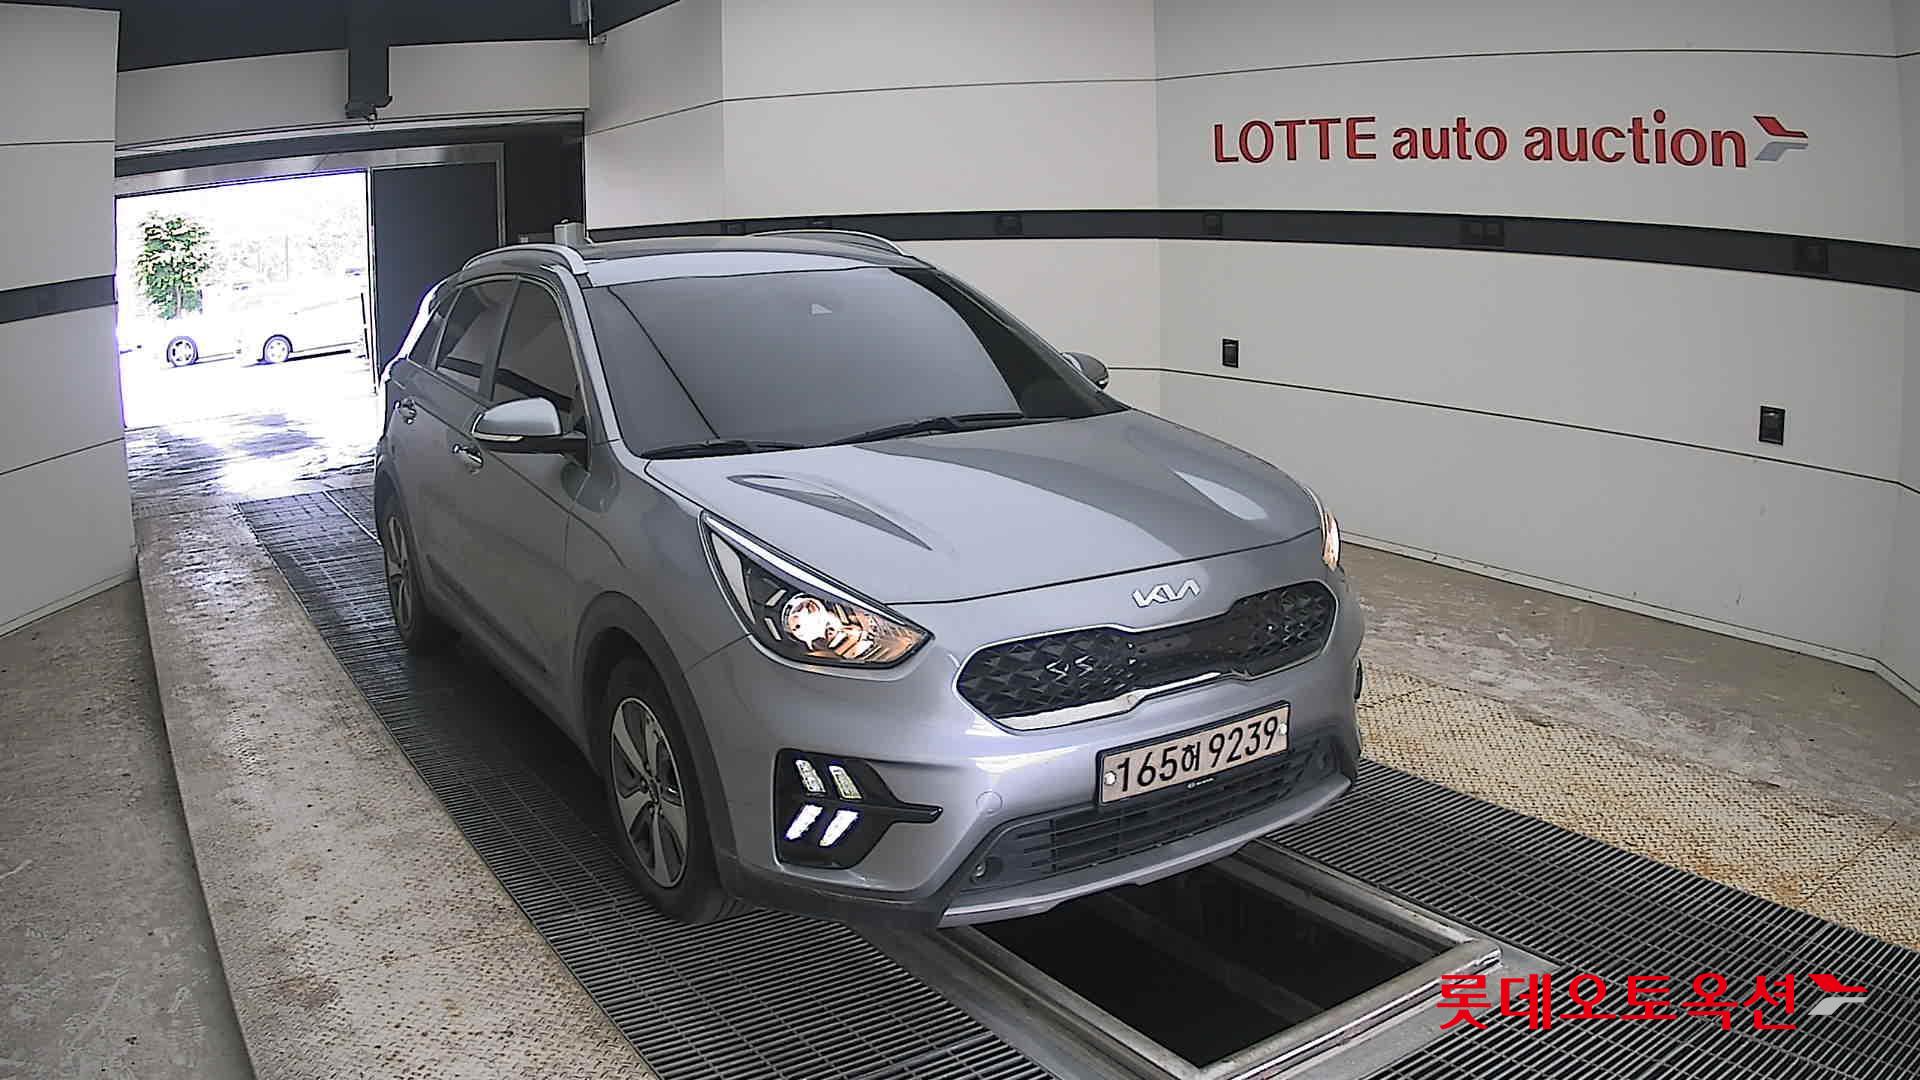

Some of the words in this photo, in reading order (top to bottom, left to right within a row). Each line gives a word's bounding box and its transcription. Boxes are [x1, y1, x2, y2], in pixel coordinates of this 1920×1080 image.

[1213, 116, 1377, 164] LOTTE
[1392, 116, 1508, 162] auto
[1523, 109, 1747, 169] auction
[1131, 578, 1201, 609] KIA
[1208, 716, 1279, 769] 9239
